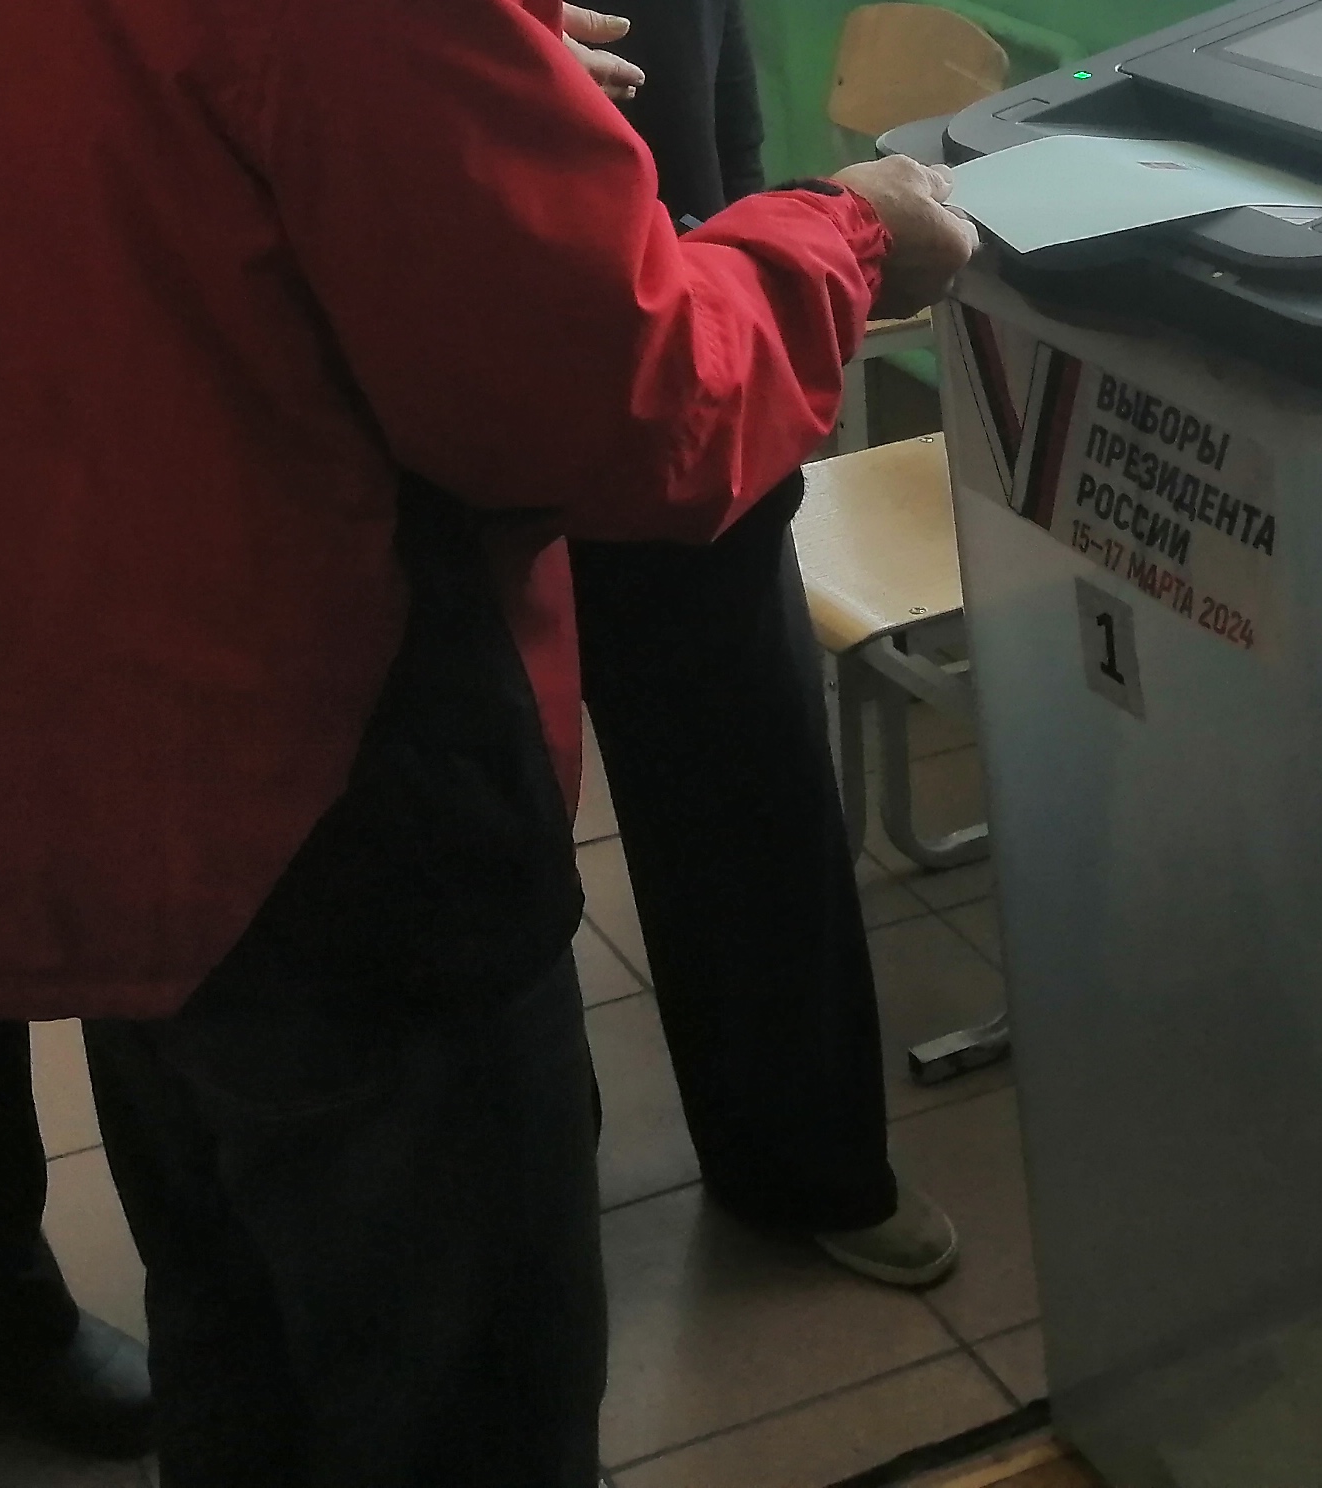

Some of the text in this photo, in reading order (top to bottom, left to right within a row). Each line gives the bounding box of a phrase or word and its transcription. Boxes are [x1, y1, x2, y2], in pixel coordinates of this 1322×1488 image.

[1096, 372, 1232, 472] ВЫБОРЫ
[1077, 472, 1192, 566] РОССИИ
[1085, 423, 1278, 557] ПРЕЗИДЕНТА
[1095, 611, 1126, 686] 1
[1126, 559, 1194, 620] МАРТА
[1197, 595, 1256, 652] 2024
